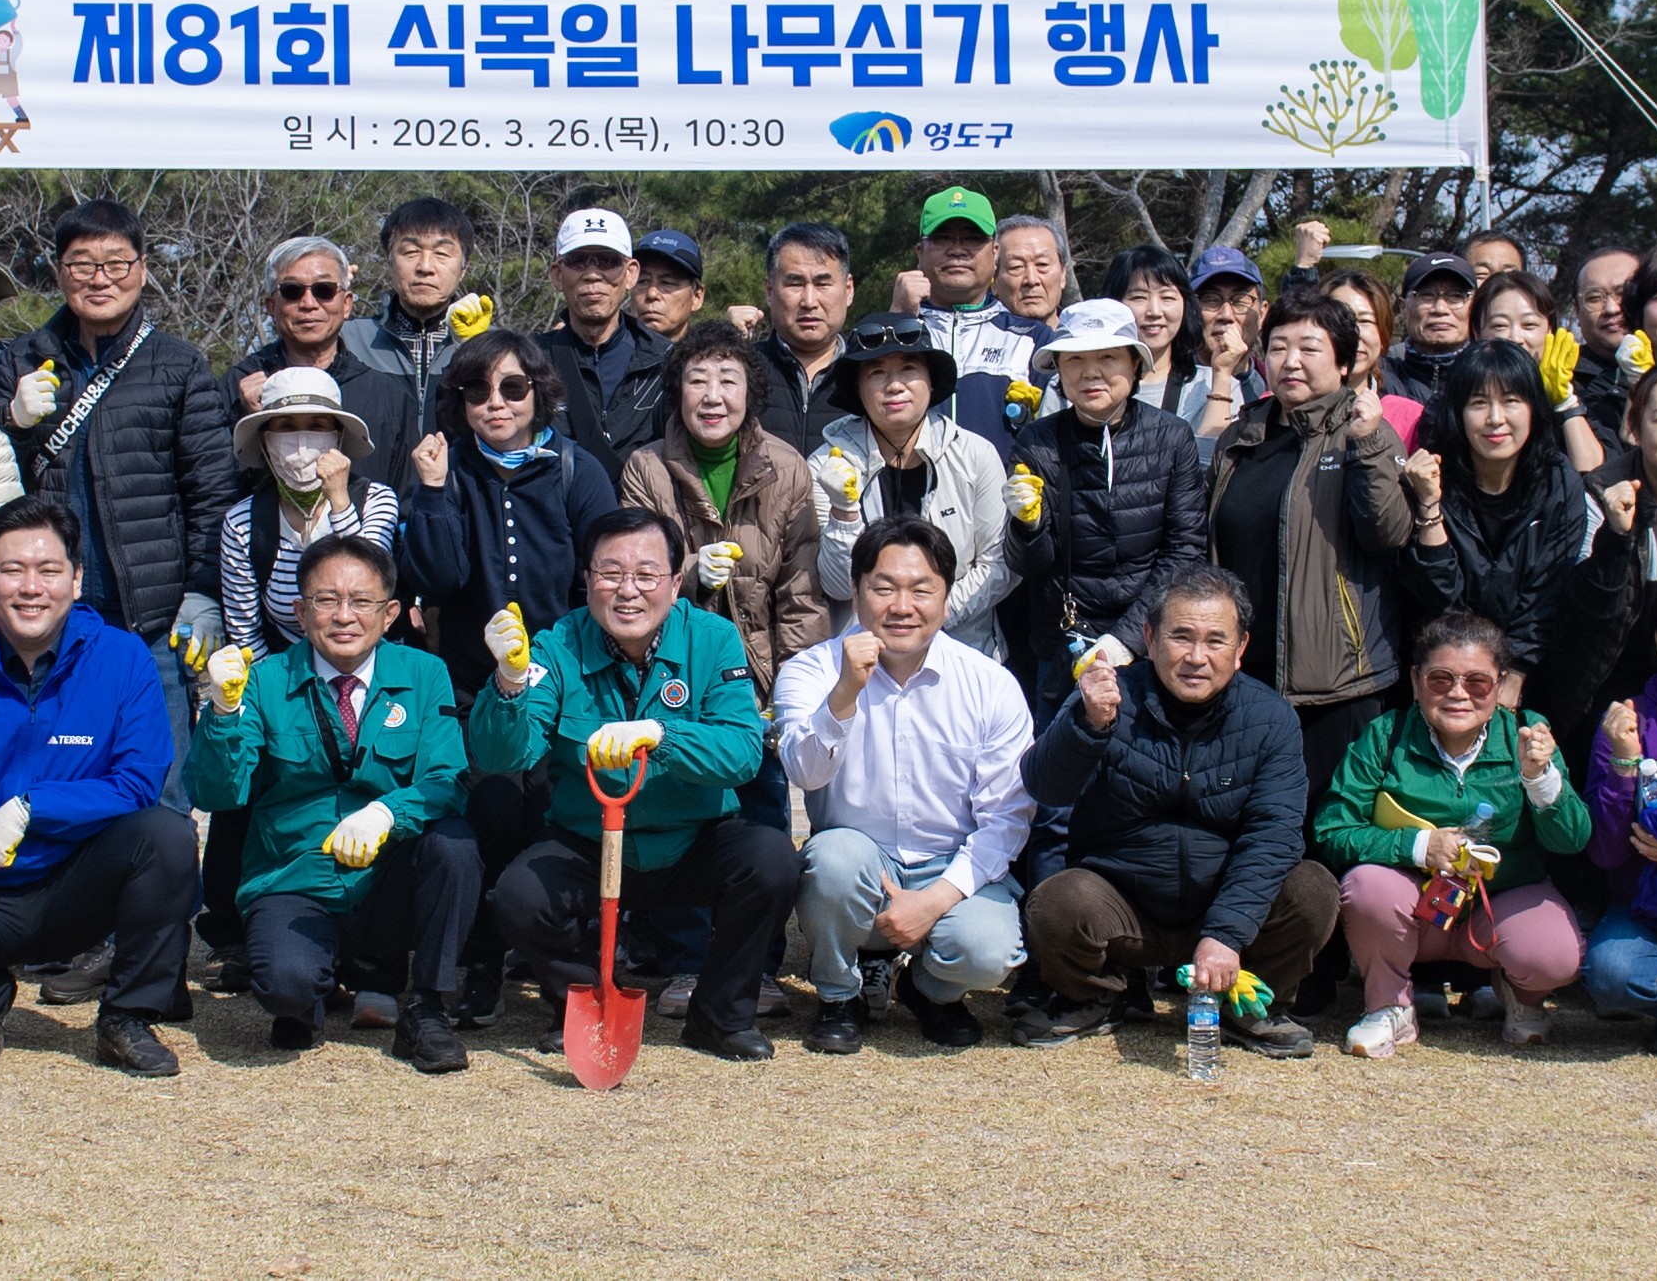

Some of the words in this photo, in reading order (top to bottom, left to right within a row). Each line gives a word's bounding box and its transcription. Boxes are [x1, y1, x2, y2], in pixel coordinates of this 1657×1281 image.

[73, 3, 349, 85] 제81회
[389, 4, 638, 87] 식목일
[677, 4, 1010, 86] 나무심기
[1046, 2, 1219, 86] 행사
[394, 119, 490, 147] 2026.
[505, 120, 533, 147] 3.
[548, 117, 668, 151] 26.(목),
[686, 119, 783, 146] 10:30
[924, 123, 1013, 151] 영도구
[940, 507, 956, 517] K2
[58, 735, 94, 746] TERREX
